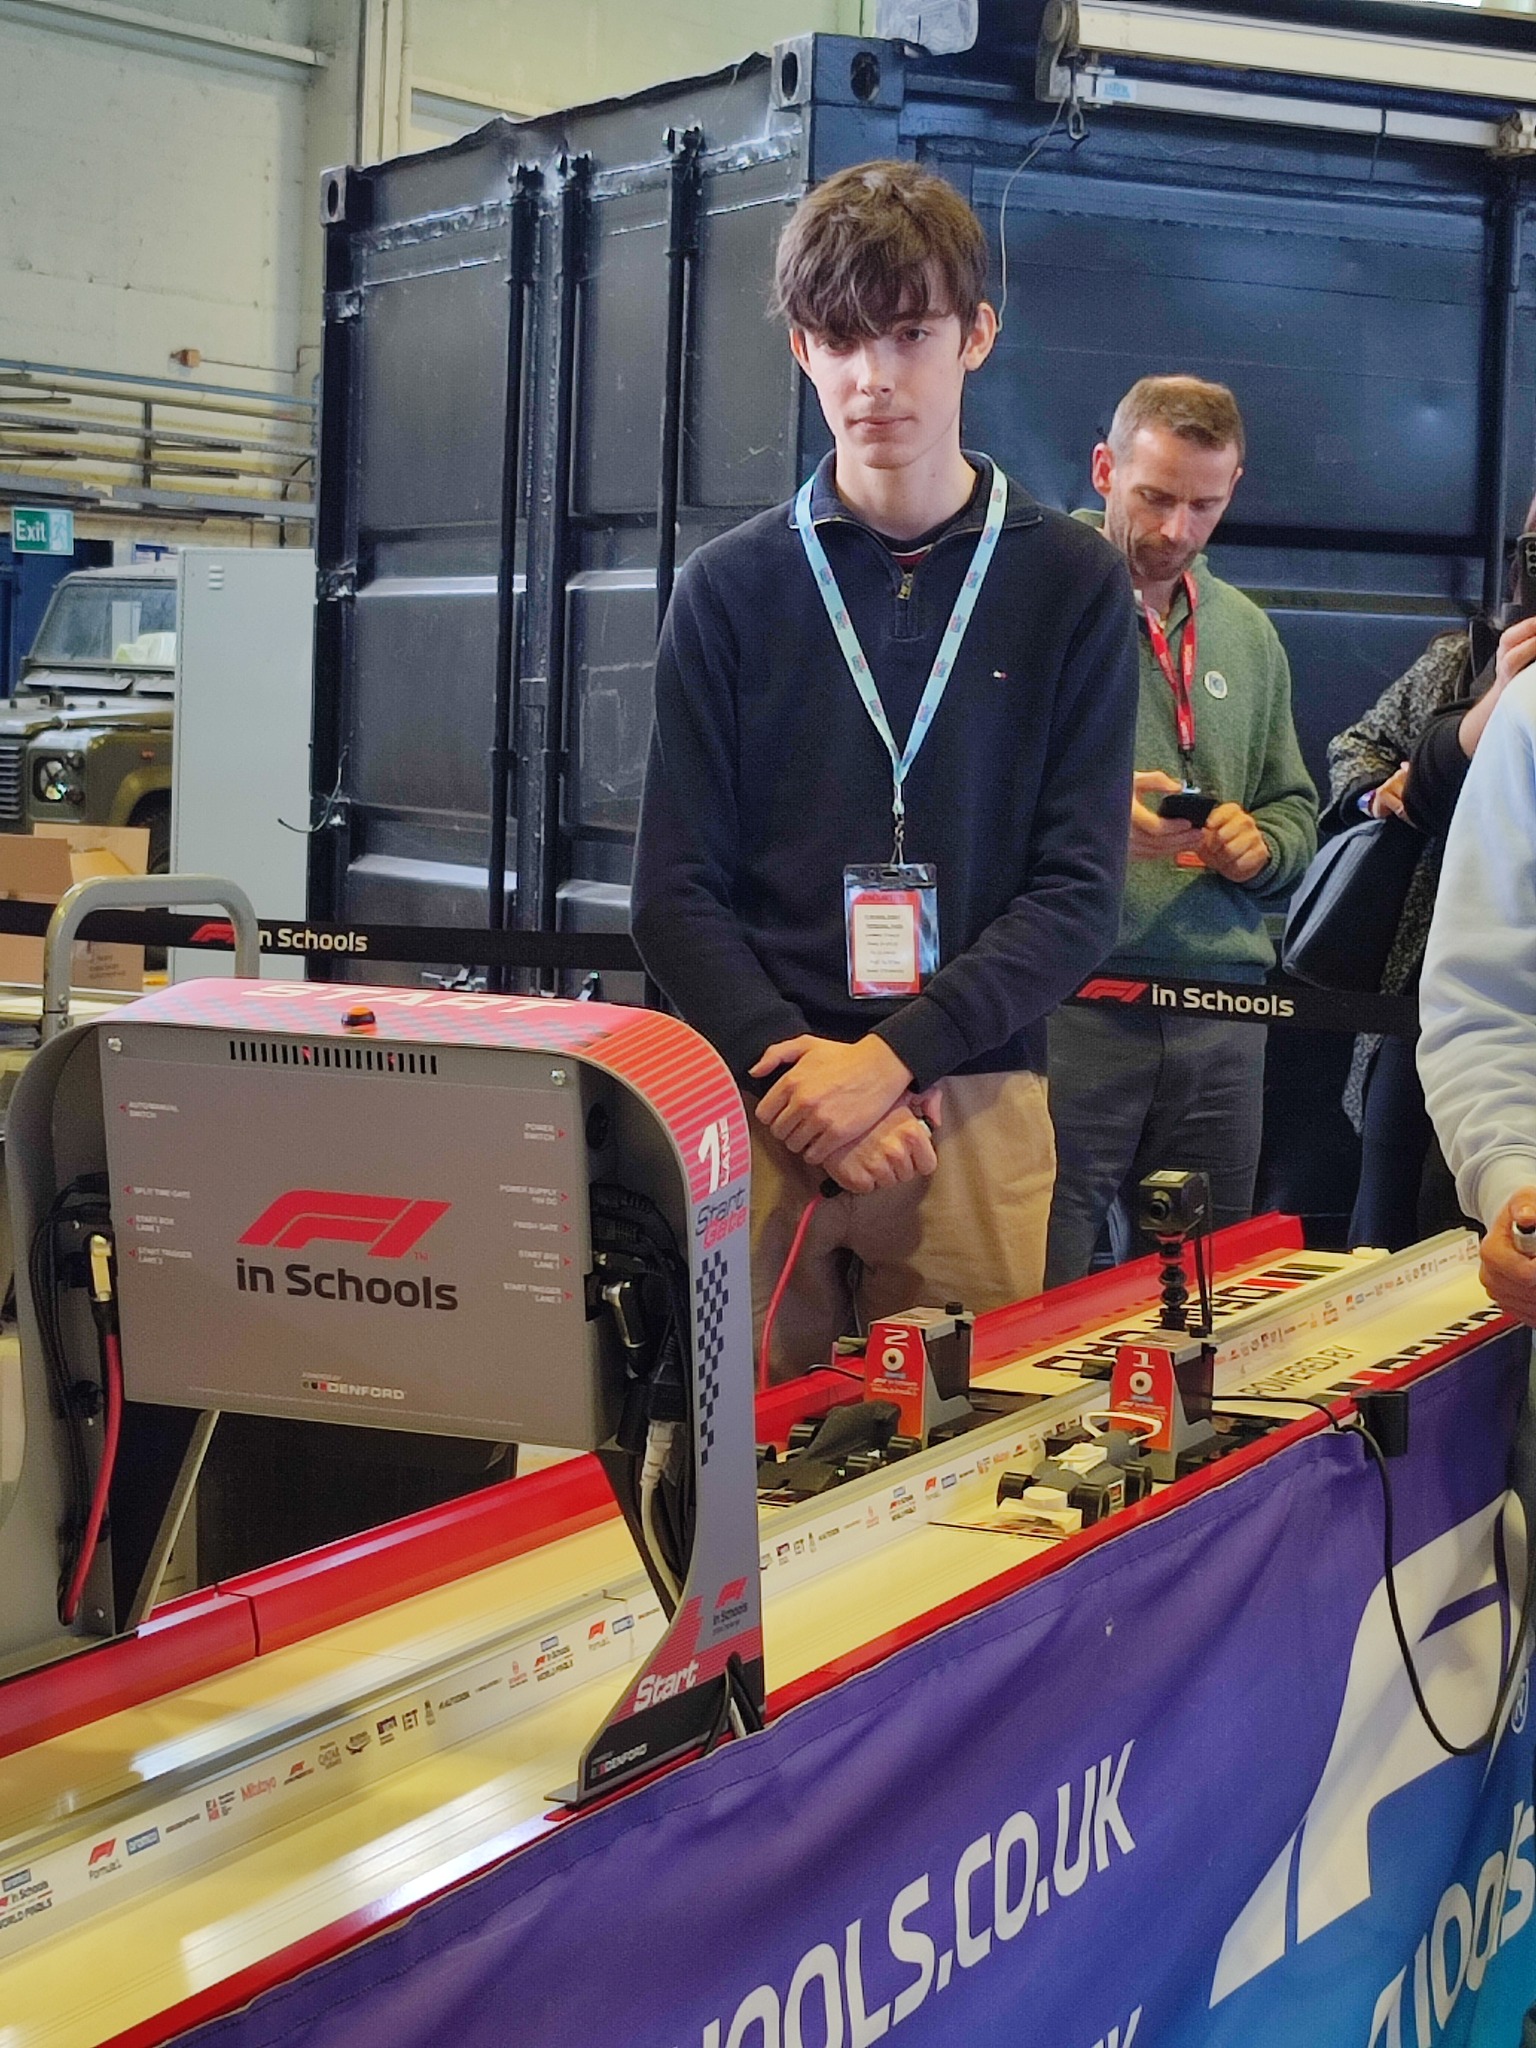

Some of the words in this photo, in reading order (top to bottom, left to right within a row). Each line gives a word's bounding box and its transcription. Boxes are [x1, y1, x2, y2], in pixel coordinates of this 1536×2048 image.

[16, 519, 47, 542] Exit
[278, 928, 368, 952] Schools
[242, 984, 574, 1013] START
[1152, 984, 1176, 1007] in
[1183, 988, 1295, 1017] Schools
[698, 1121, 720, 1194] 1
[695, 1187, 746, 1236] Start
[703, 1205, 748, 1250] Gate
[236, 1257, 274, 1293] in
[284, 1263, 459, 1311] Schools
[1238, 1352, 1340, 1397] POWERED
[1333, 1343, 1362, 1361] BY
[326, 1380, 406, 1400] DENFORD
[633, 1659, 700, 1713] Start
[604, 1742, 648, 1771] DENFORD
